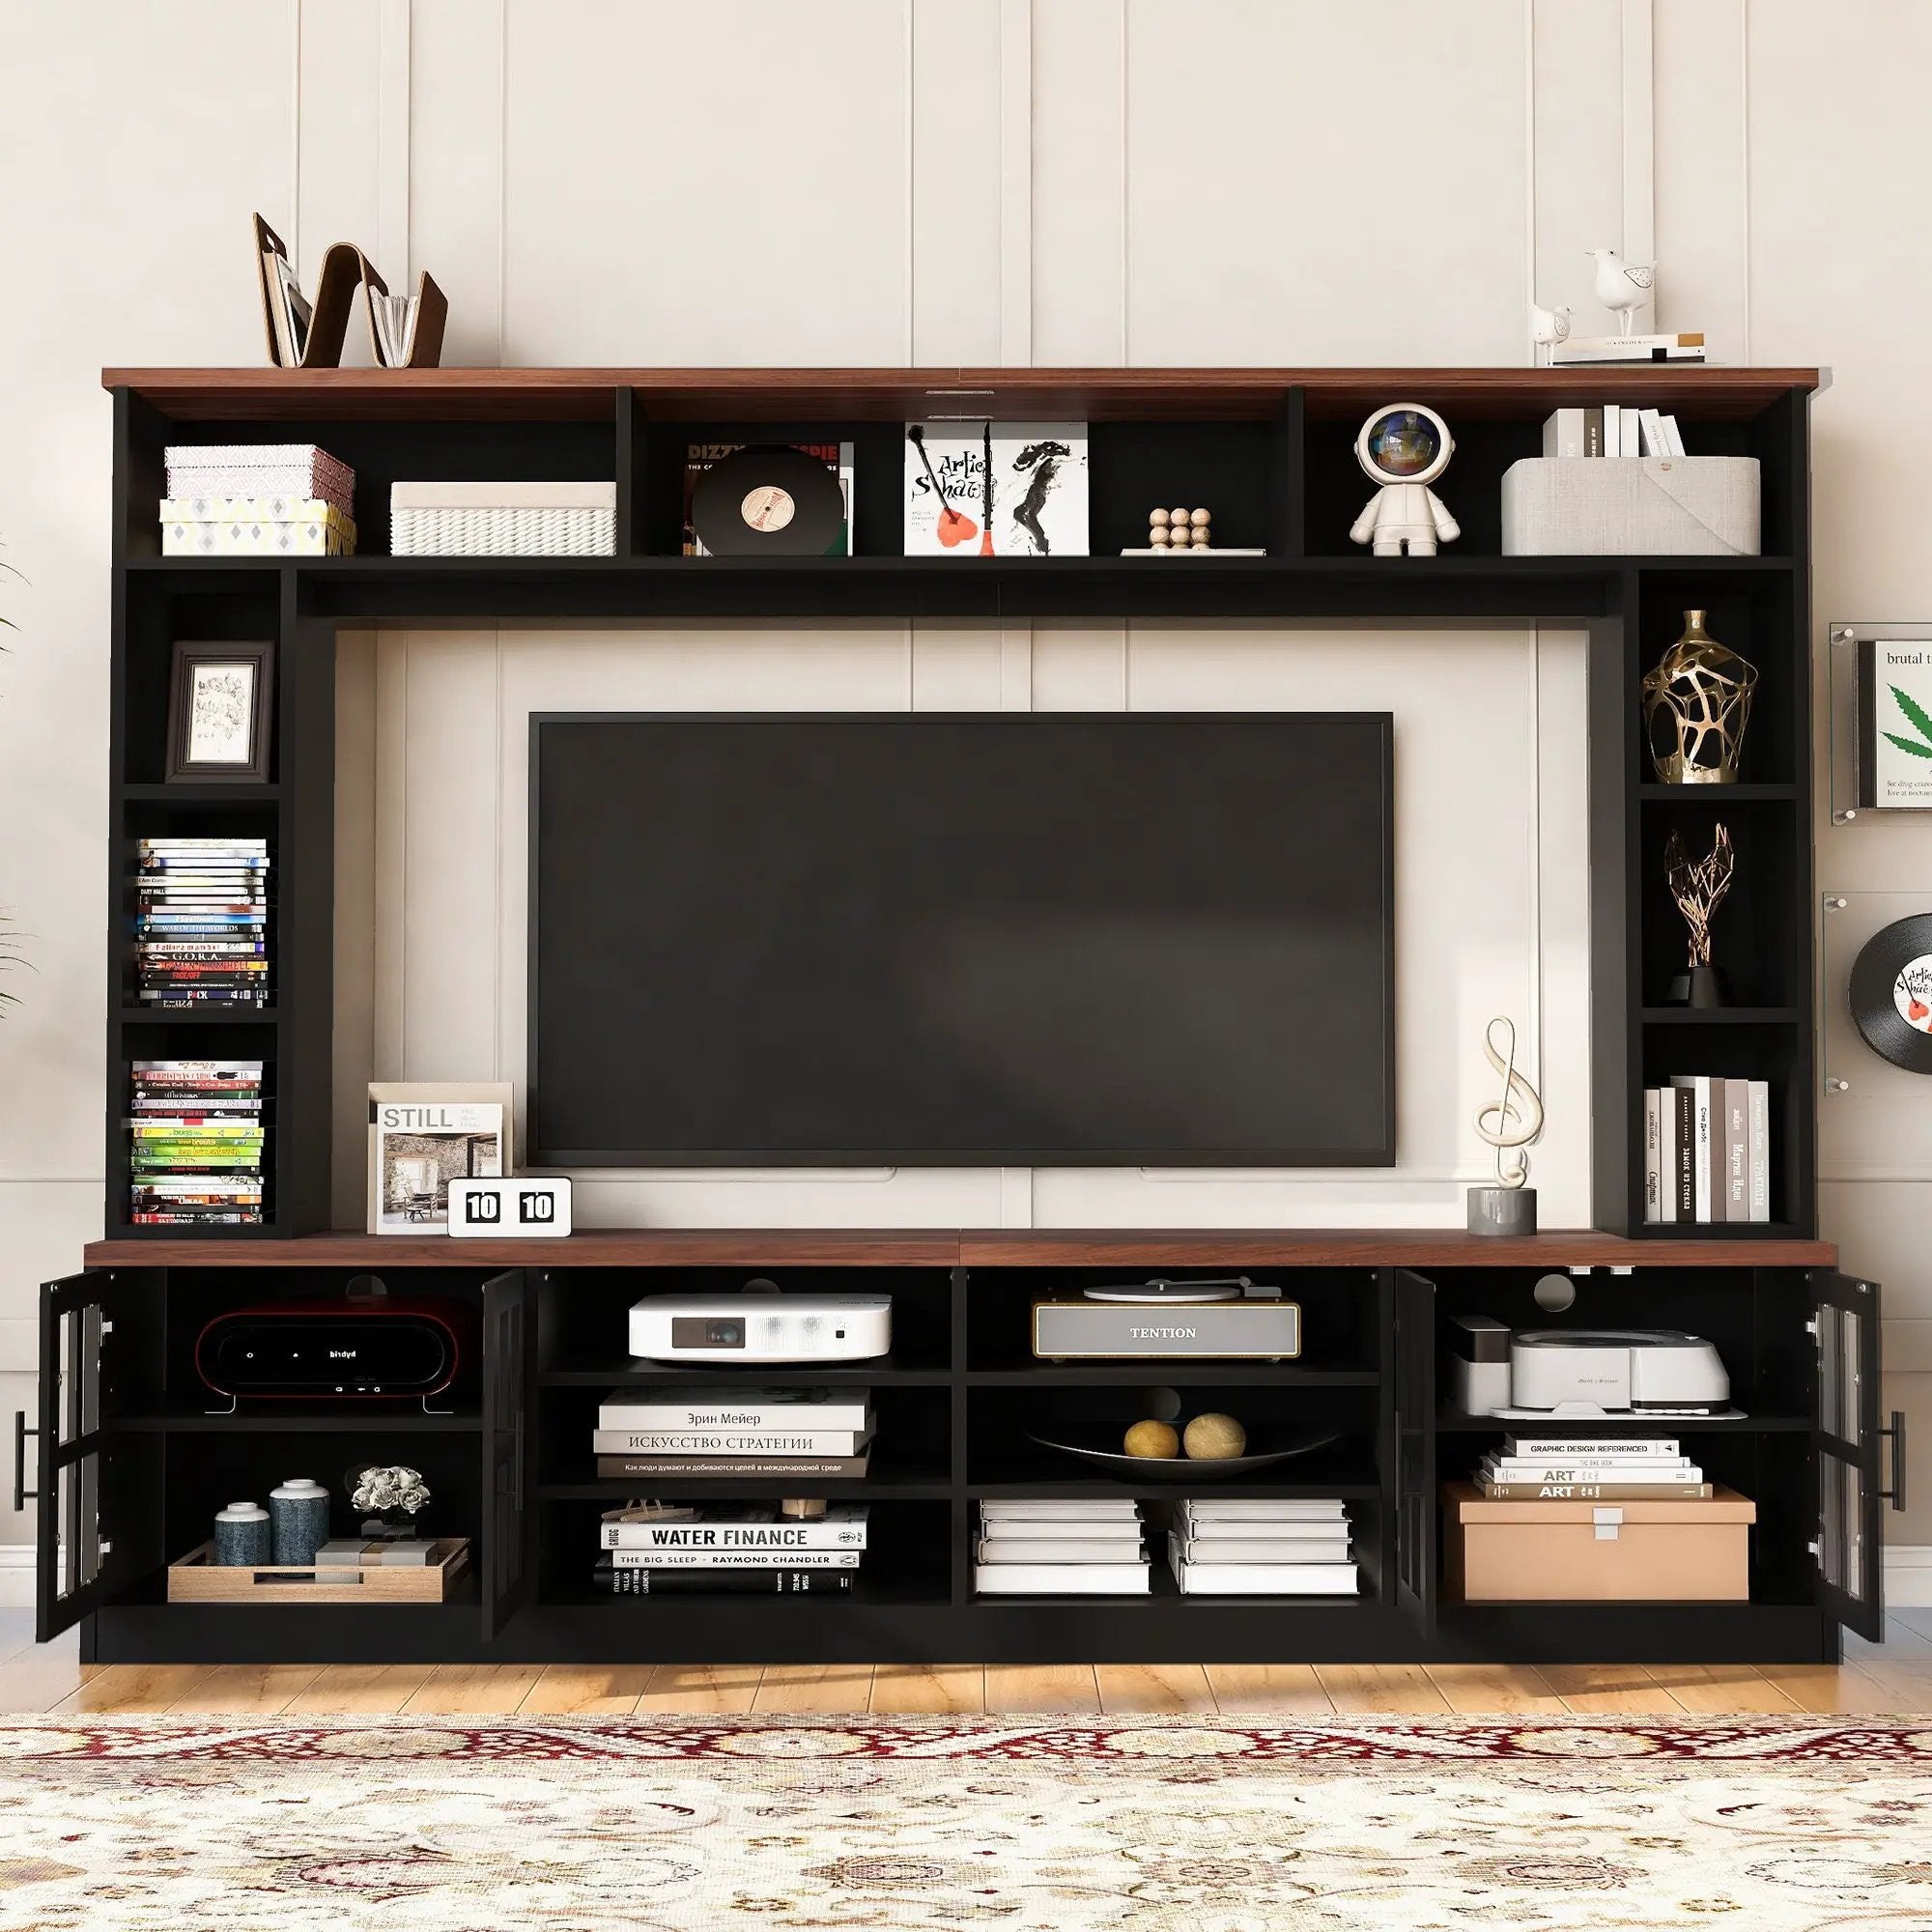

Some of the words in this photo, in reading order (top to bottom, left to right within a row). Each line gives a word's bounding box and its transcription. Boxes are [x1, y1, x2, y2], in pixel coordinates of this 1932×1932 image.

[1887, 652, 1922, 665] brutal
[384, 1108, 453, 1127] STILL
[468, 1195, 497, 1219] 10
[522, 1195, 552, 1219] 10
[1129, 1327, 1197, 1339] TENTION
[687, 1412, 718, 1426] Эрин
[721, 1412, 761, 1426] Мейер
[629, 1436, 722, 1449] ИСКУССТВО
[726, 1437, 813, 1450] СТРАТЕГИИ
[692, 1463, 734, 1472] добиваются
[734, 1463, 756, 1472] целей
[763, 1463, 820, 1472] международной
[1543, 1470, 1576, 1481] ART
[1539, 1486, 1576, 1497] ART
[652, 1530, 716, 1546] WATER
[724, 1530, 808, 1546] FINANCE
